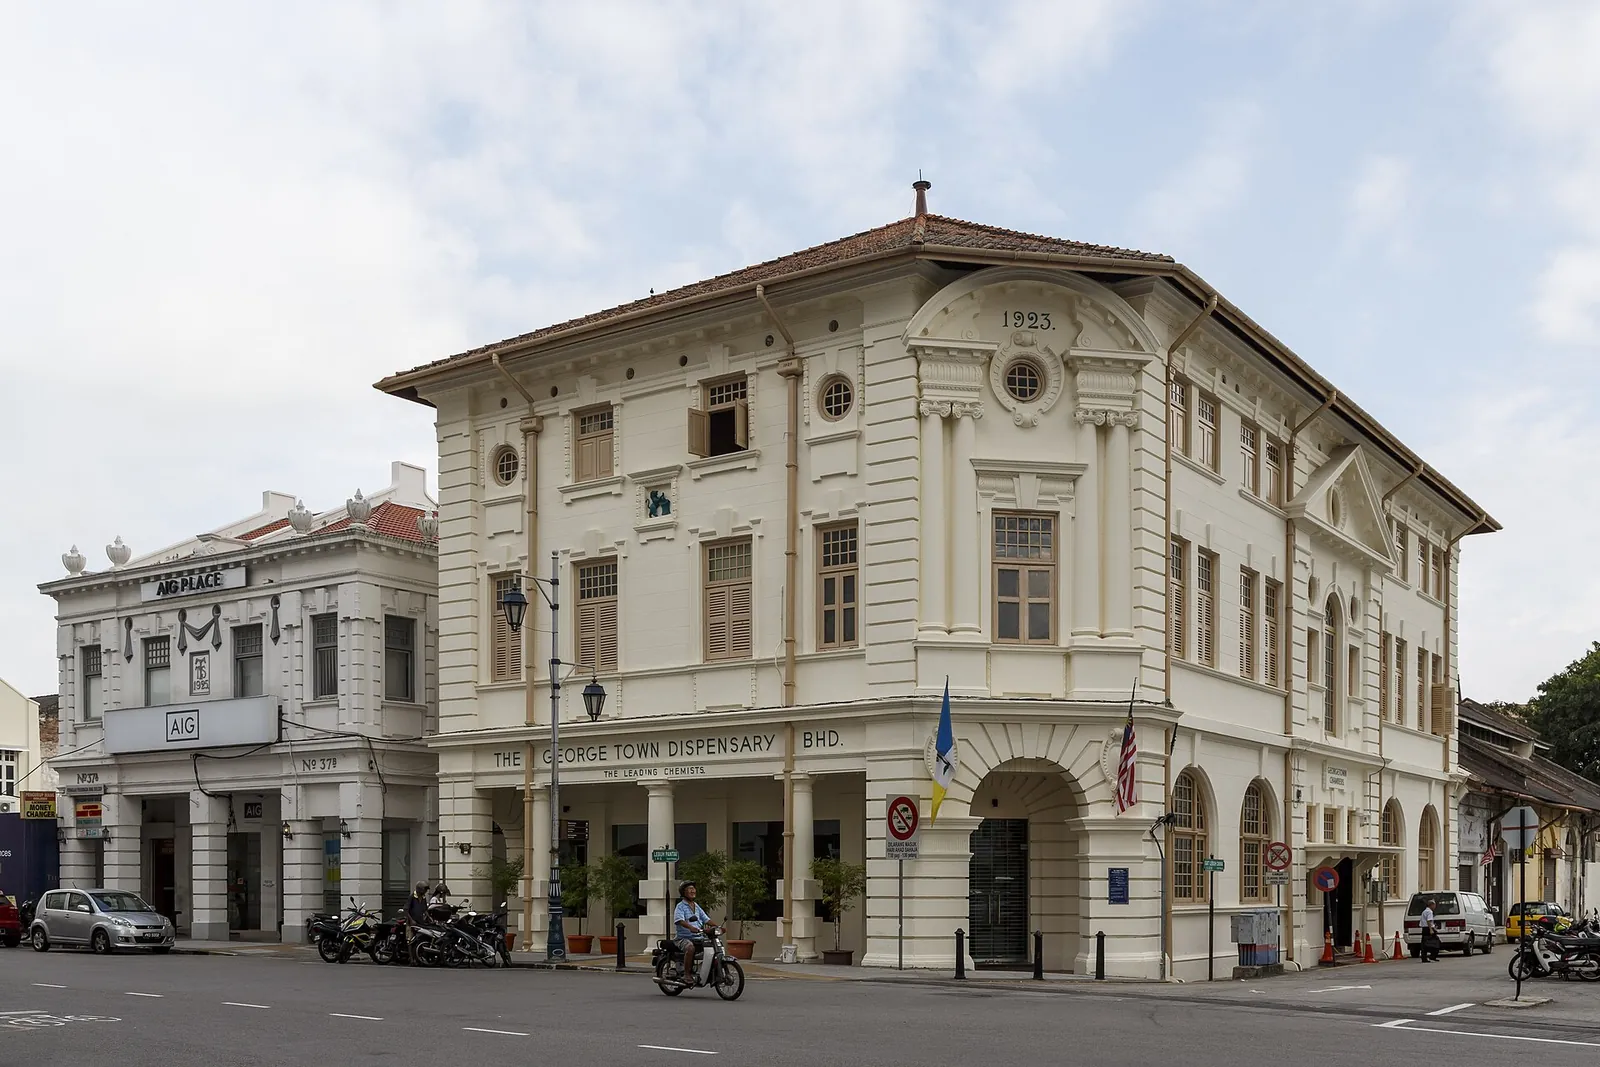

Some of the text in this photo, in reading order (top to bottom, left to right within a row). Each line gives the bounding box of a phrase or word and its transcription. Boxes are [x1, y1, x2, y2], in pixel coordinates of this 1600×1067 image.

[156, 572, 224, 596] AIG PLACE
[170, 716, 196, 736] AIG
[494, 730, 844, 767] THE GEORGE TOWN DISPENSARY BHD.
[604, 770, 619, 778] THE
[624, 768, 658, 777] LEADING
[246, 804, 262, 816] AIG
